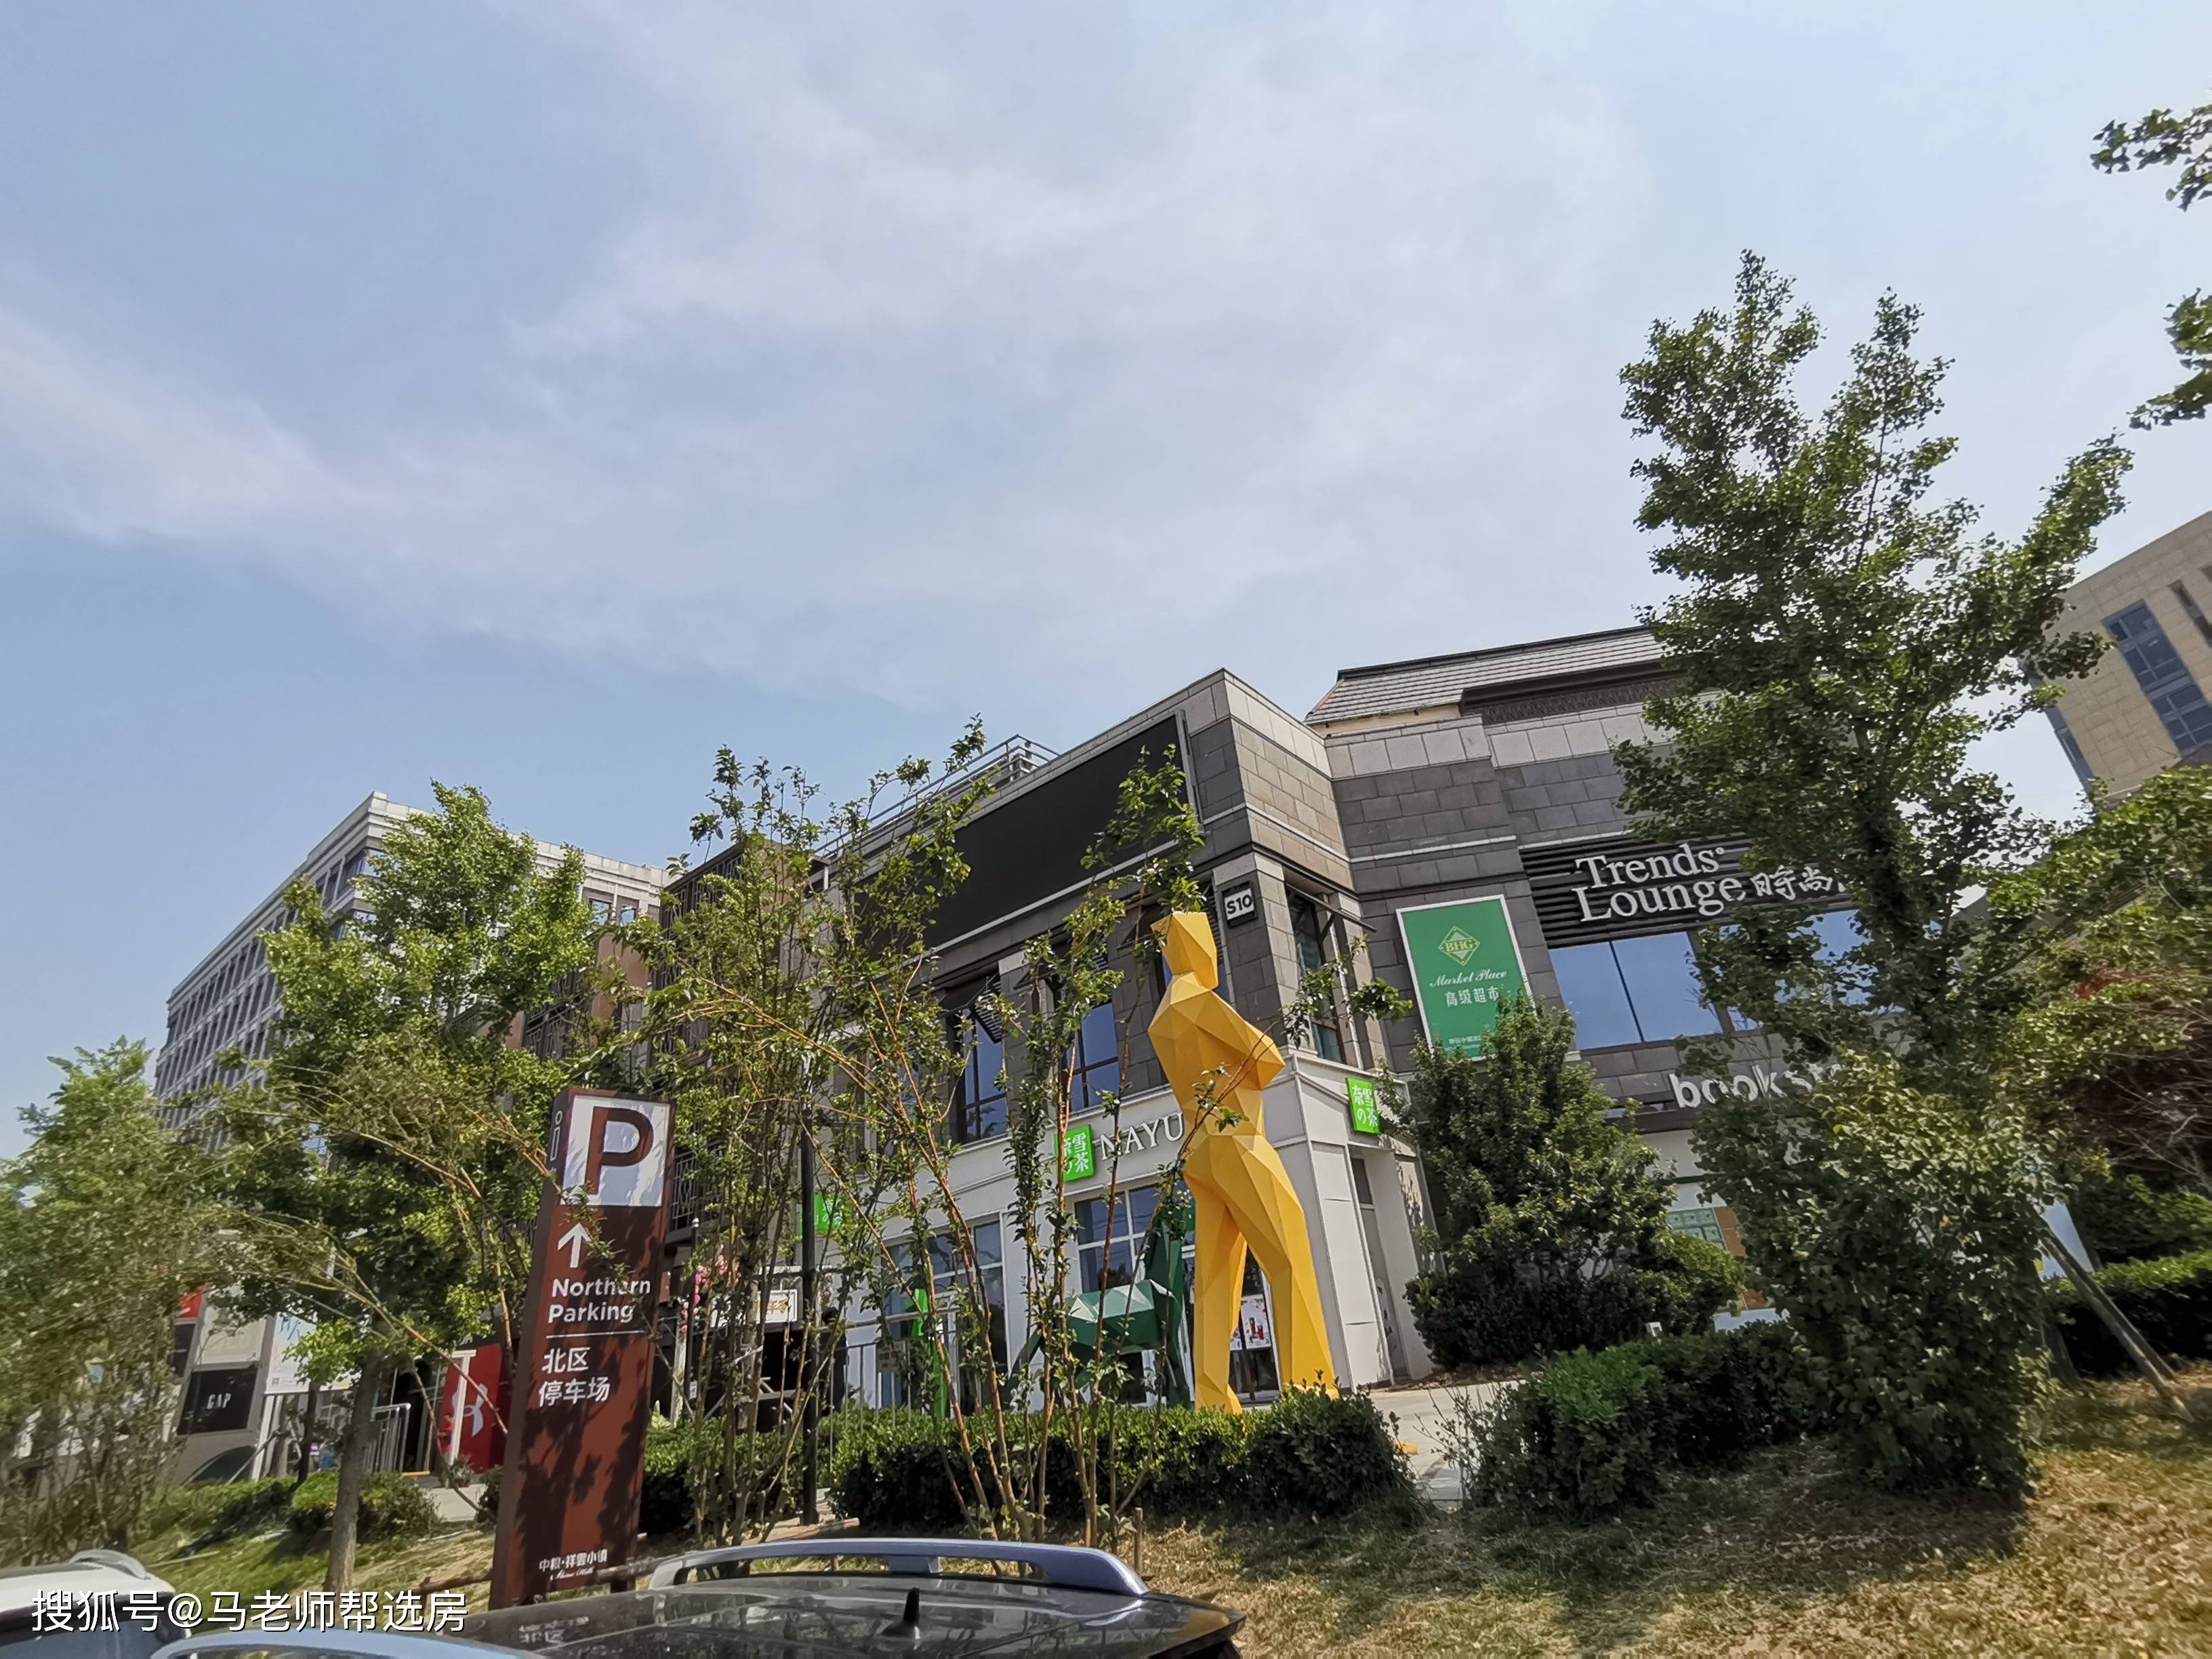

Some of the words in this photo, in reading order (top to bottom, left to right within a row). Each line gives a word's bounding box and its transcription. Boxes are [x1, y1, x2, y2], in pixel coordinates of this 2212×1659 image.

[1576, 843, 1720, 888] Trends
[1226, 894, 1253, 914] S10
[1571, 877, 1746, 922] Lounge
[1444, 939, 1473, 952] BHG
[1429, 971, 1474, 987] Market
[1475, 968, 1508, 982] Place
[1444, 986, 1500, 1008] 高级超市
[585, 1106, 654, 1195] P
[552, 1277, 651, 1298] Northern
[548, 1302, 634, 1324] Parking
[541, 1347, 591, 1374] 北区
[207, 1393, 232, 1410] GAP
[538, 1376, 610, 1408] 停车场
